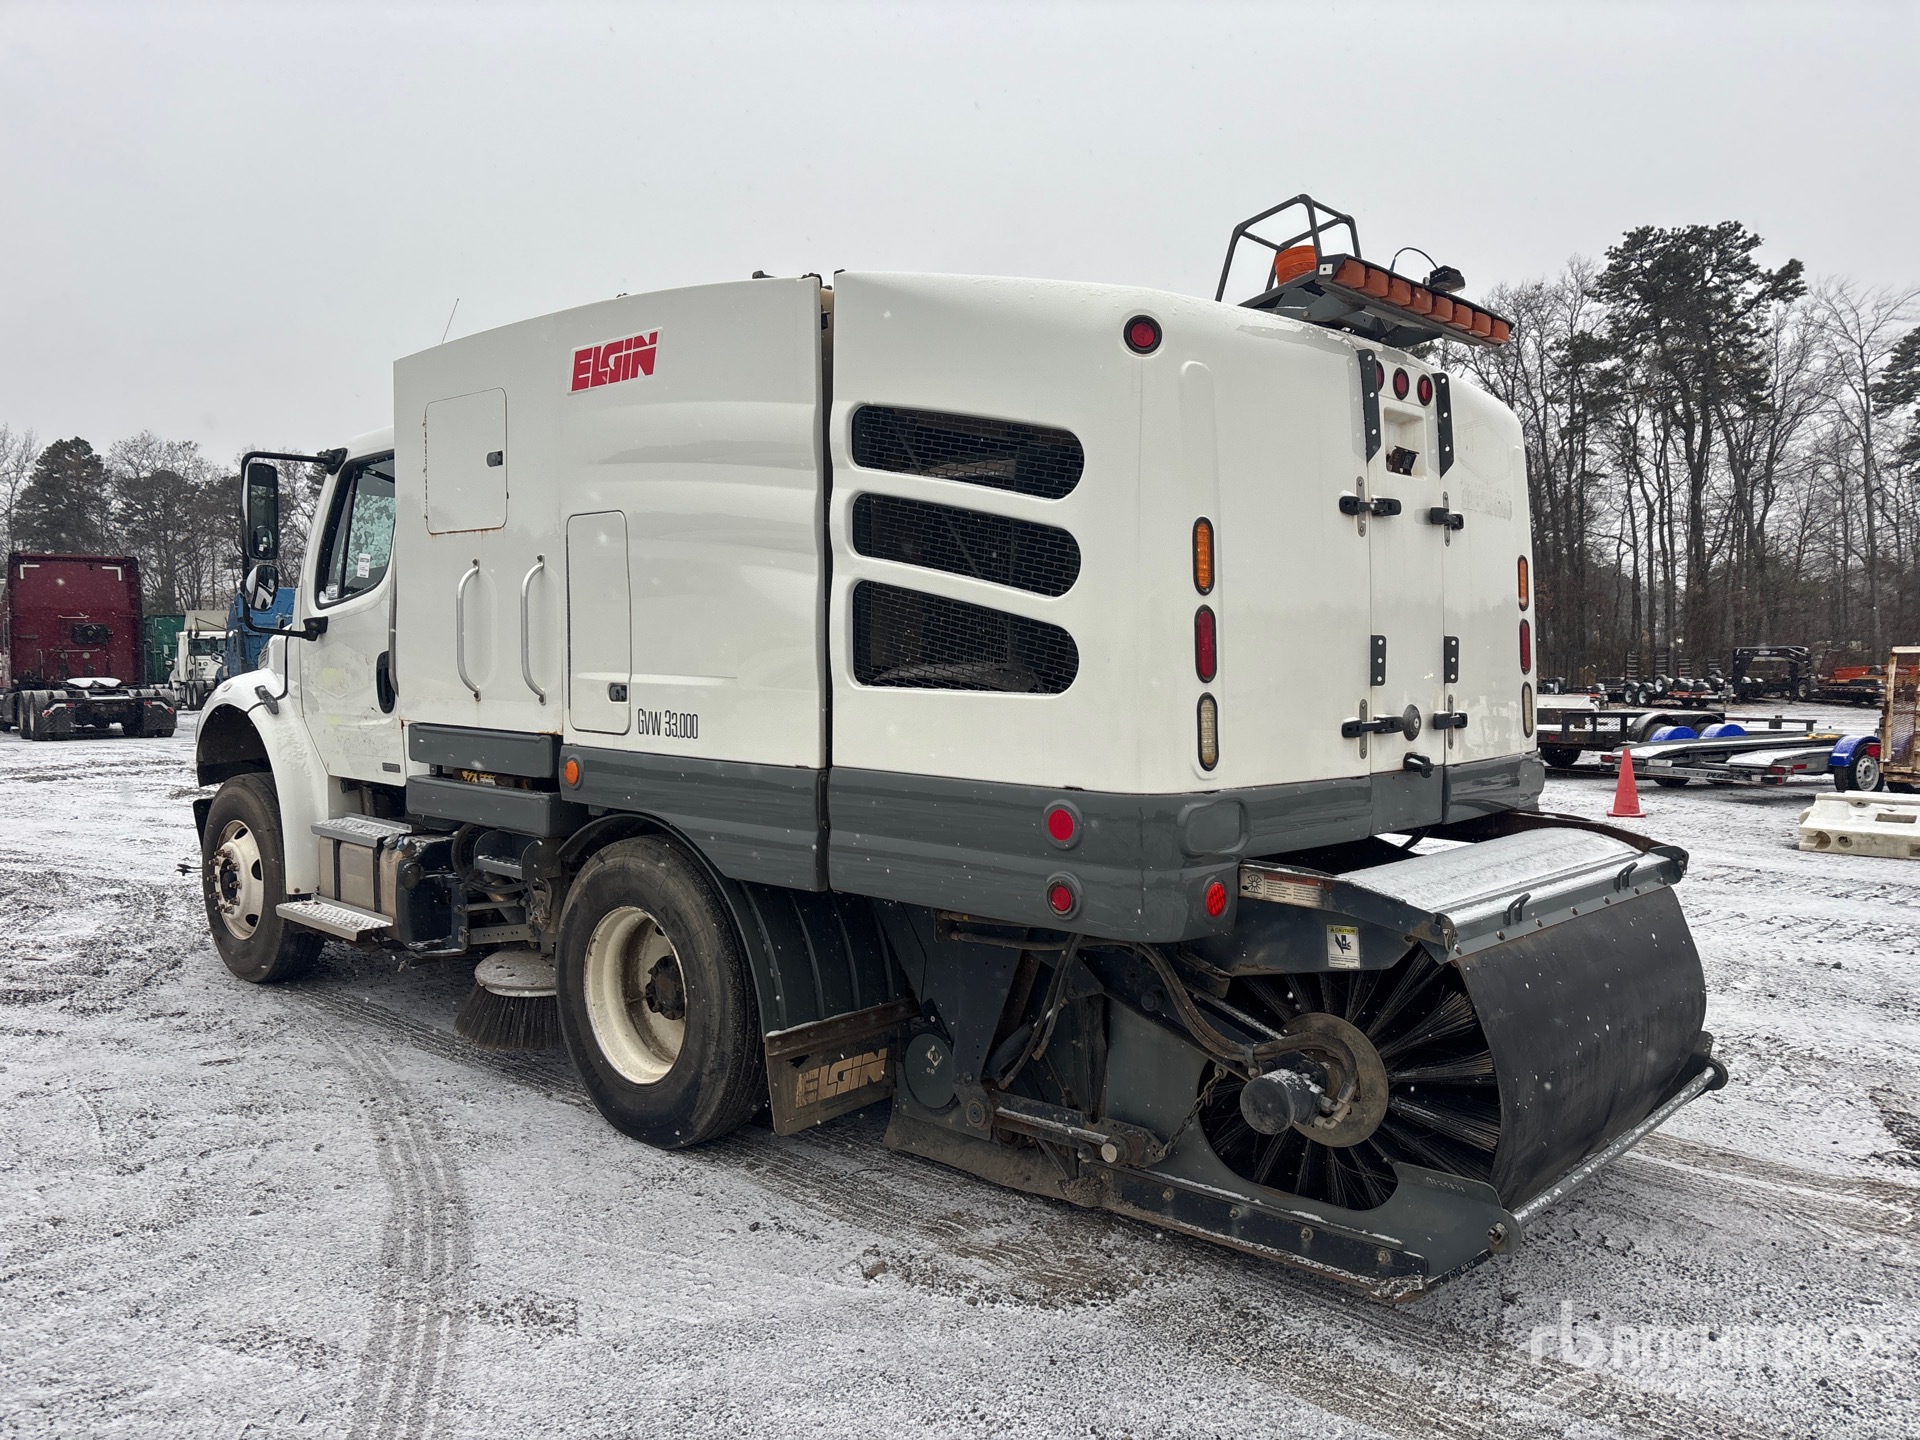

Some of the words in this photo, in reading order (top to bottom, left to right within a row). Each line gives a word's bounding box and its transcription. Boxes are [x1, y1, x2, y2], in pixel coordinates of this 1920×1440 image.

[571, 330, 659, 392] ELGIN
[637, 708, 662, 736] GVW
[664, 709, 698, 739] 33,000
[795, 1047, 888, 1109] ELGIN
